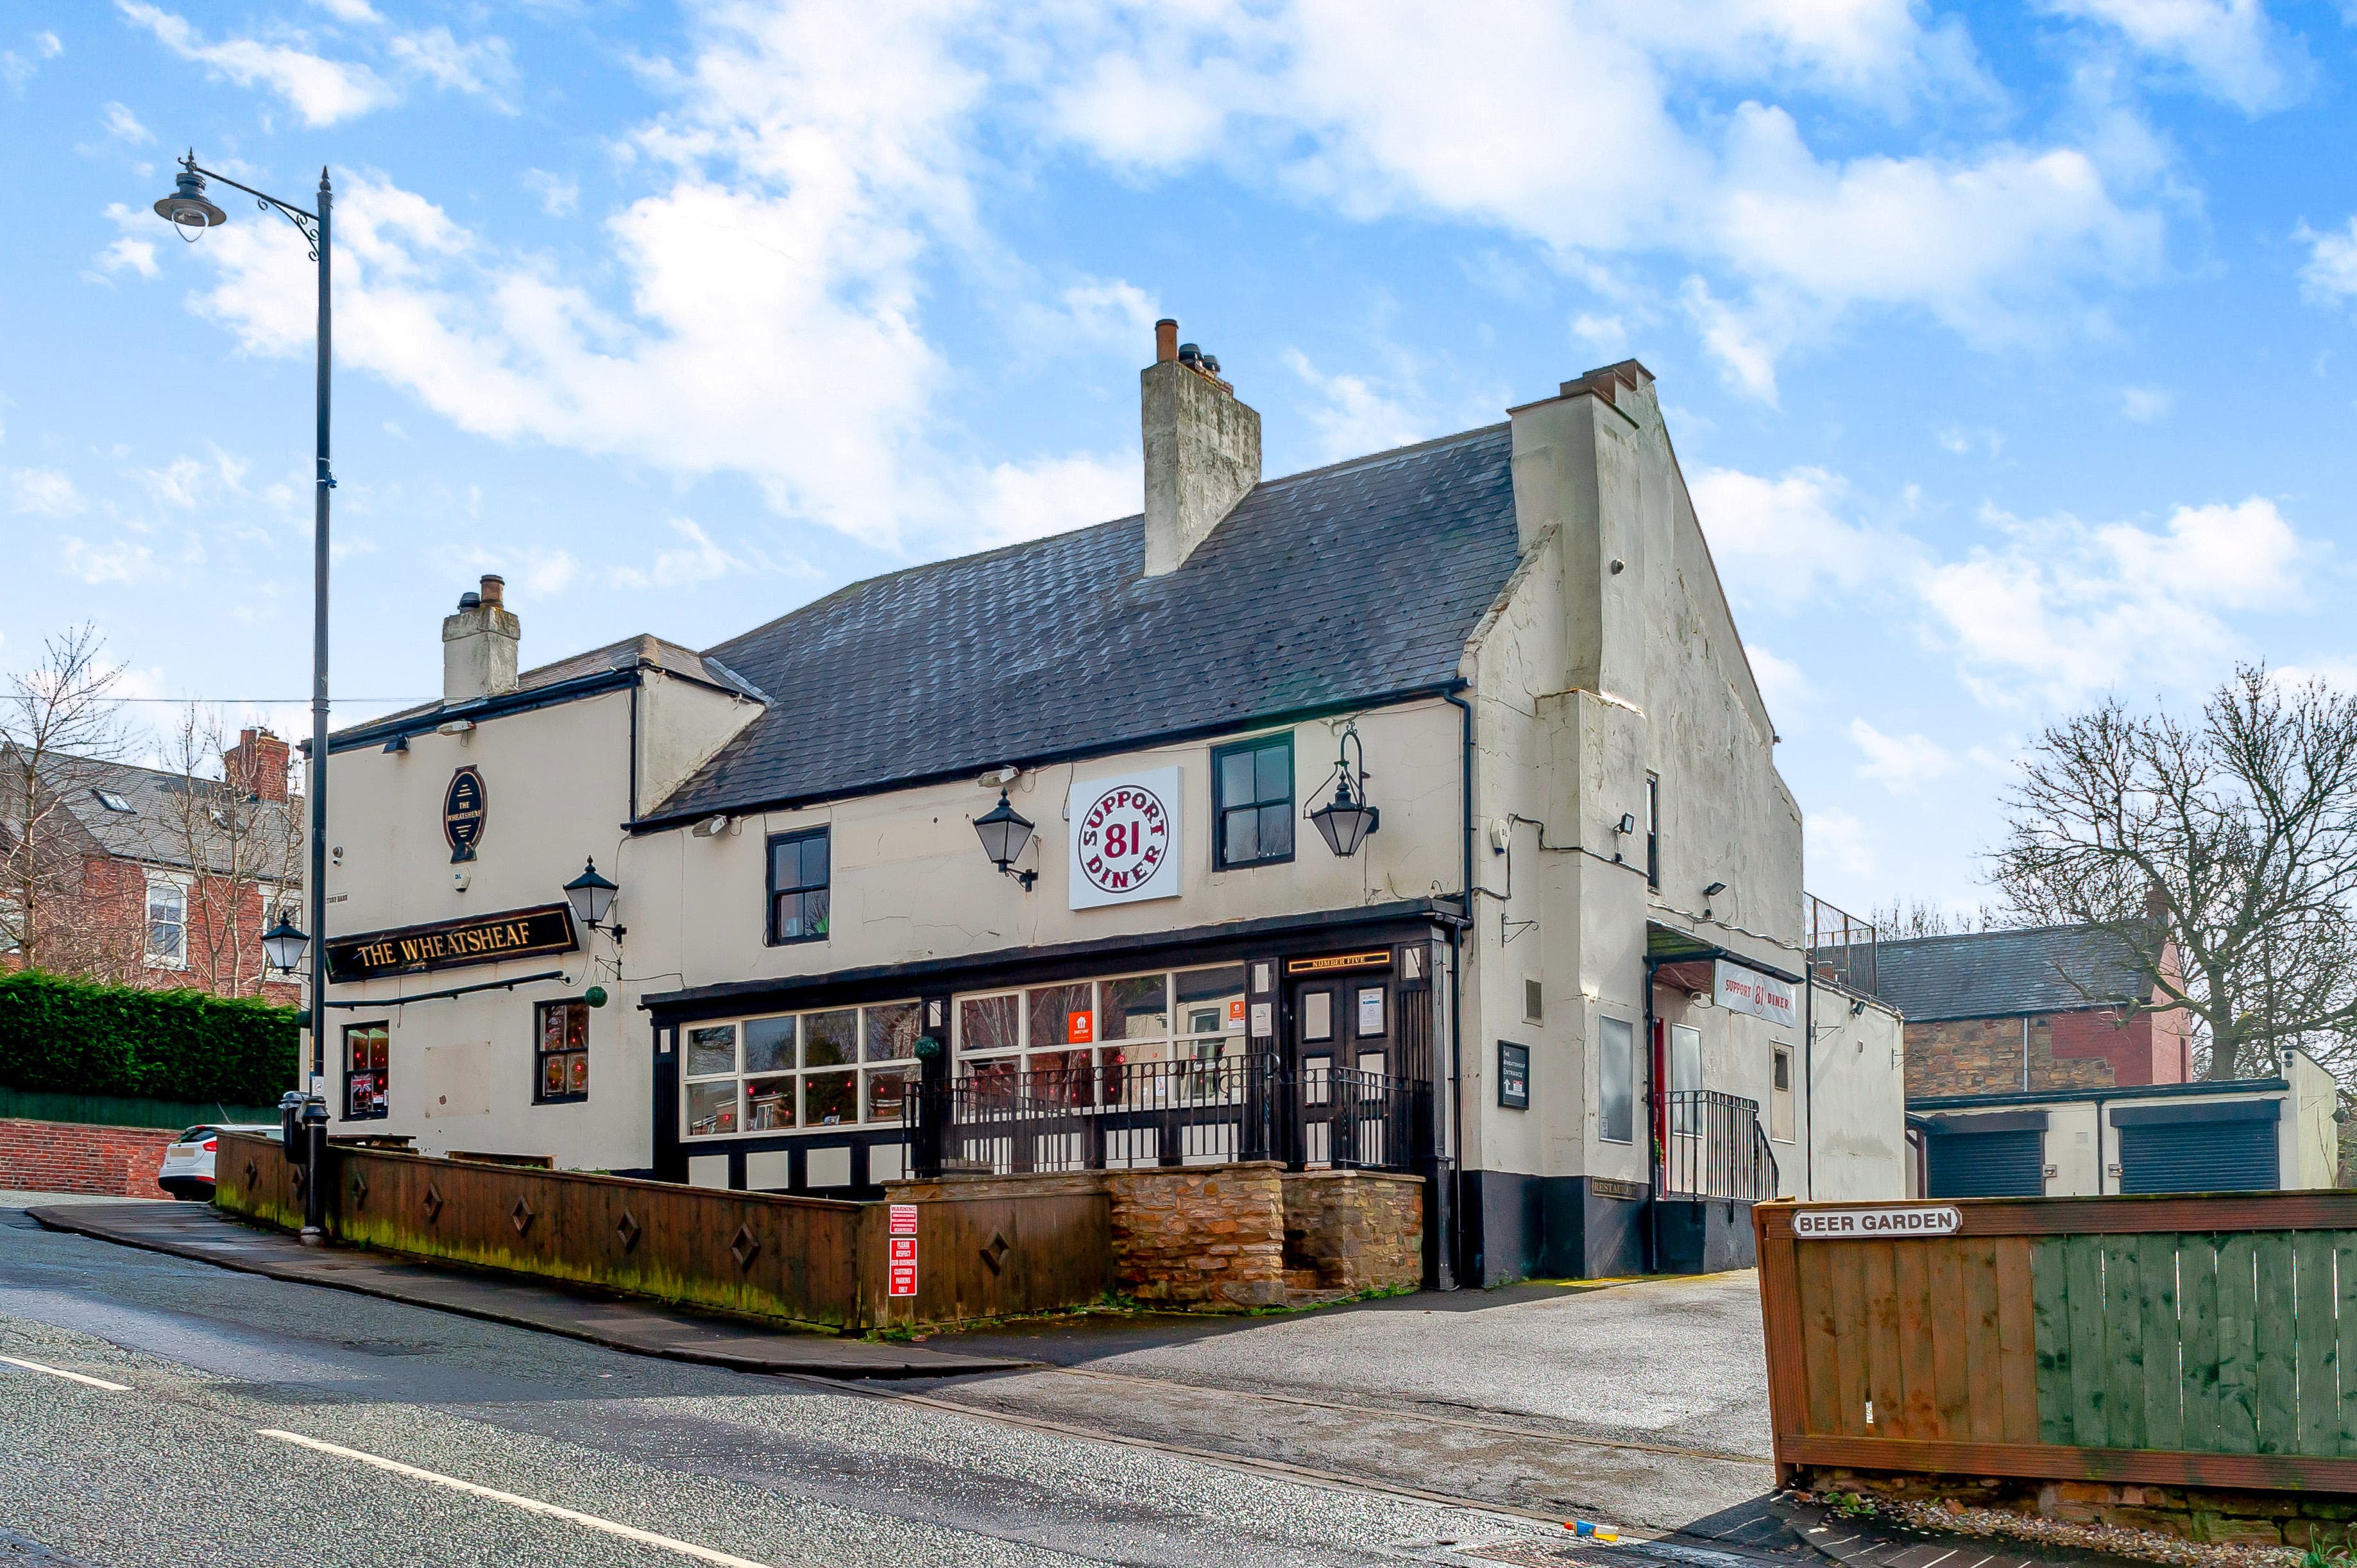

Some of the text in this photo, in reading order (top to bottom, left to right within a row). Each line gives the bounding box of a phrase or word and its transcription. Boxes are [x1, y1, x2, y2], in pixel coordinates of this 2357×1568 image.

[1084, 790, 1164, 846] SUPPORT
[1104, 821, 1139, 858] 81
[1086, 845, 1161, 888] DINER
[358, 923, 529, 966] THE WHEATSHEAF
[1313, 956, 1365, 967] NUMBER FIVE
[1726, 979, 1789, 1010] SUPPORT 81 DINER
[1800, 1212, 1952, 1231] BEER GARDEN
